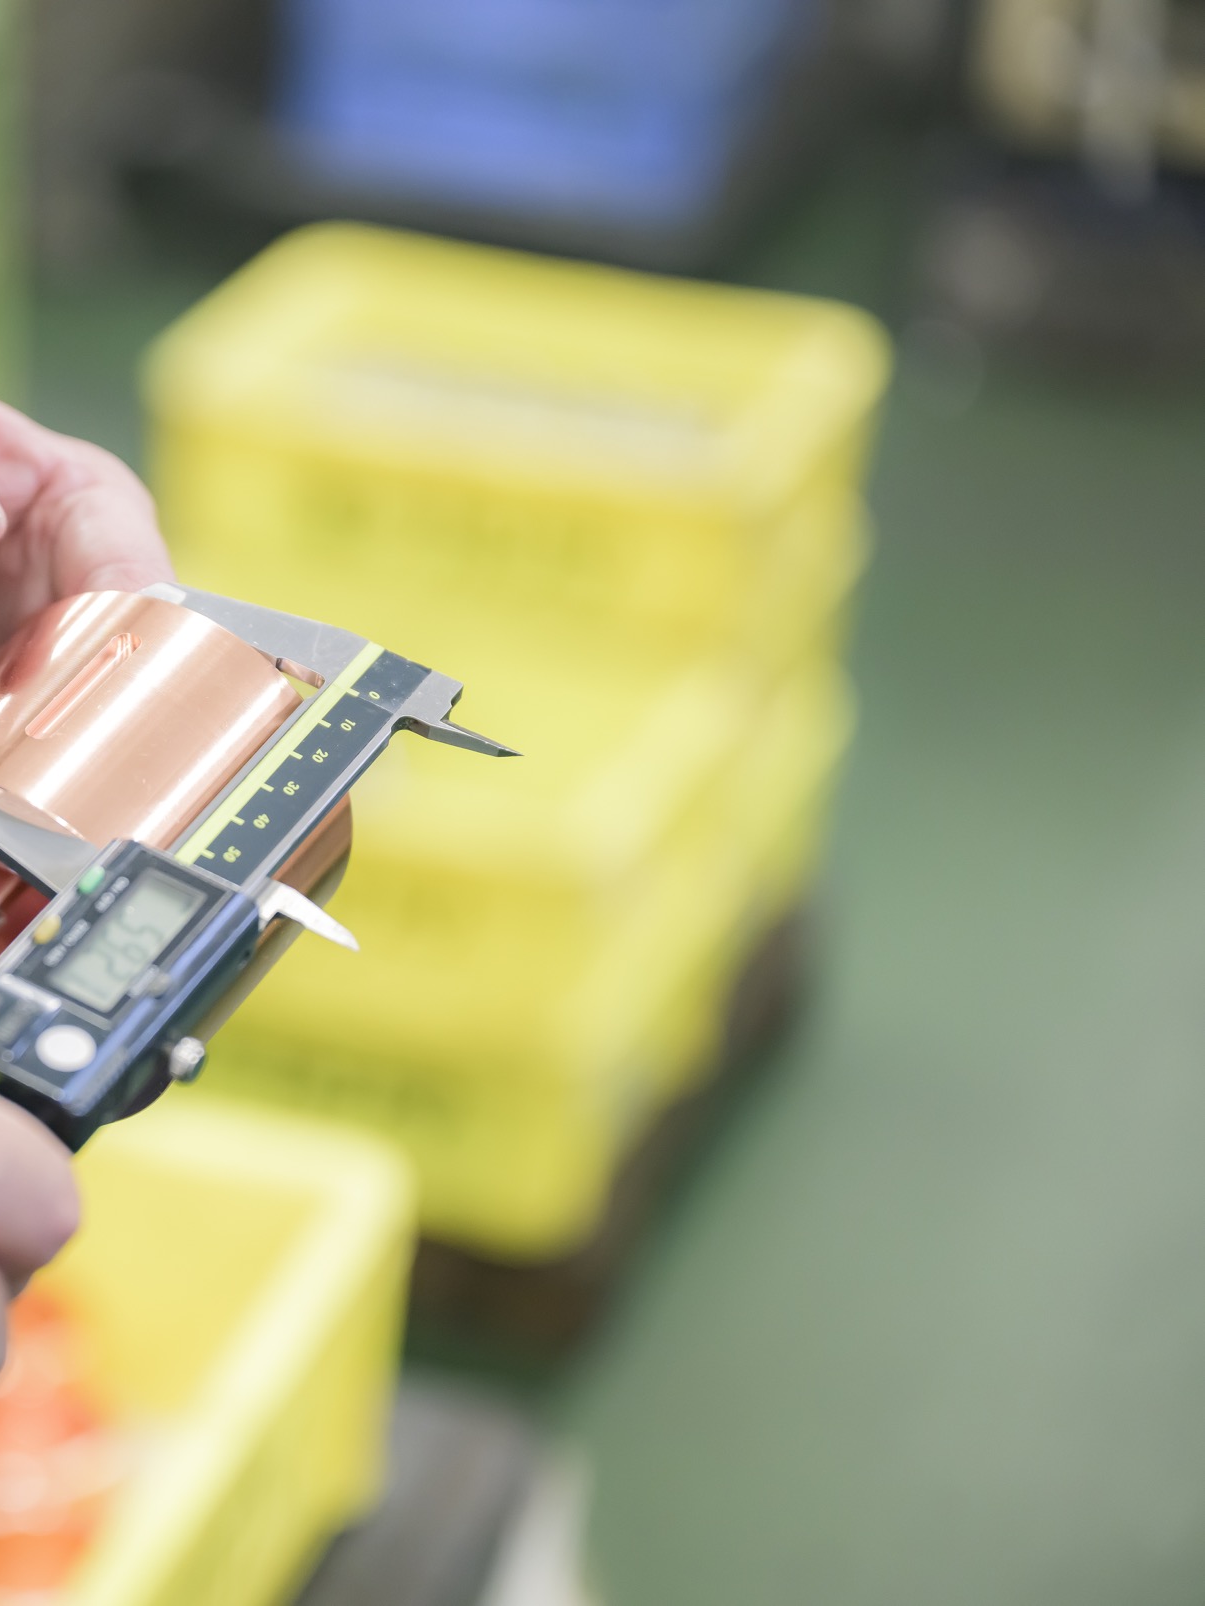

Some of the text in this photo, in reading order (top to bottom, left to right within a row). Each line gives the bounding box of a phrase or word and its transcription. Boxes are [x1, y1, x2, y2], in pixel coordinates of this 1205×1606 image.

[222, 690, 381, 863] 0 10 20 30 40 50
